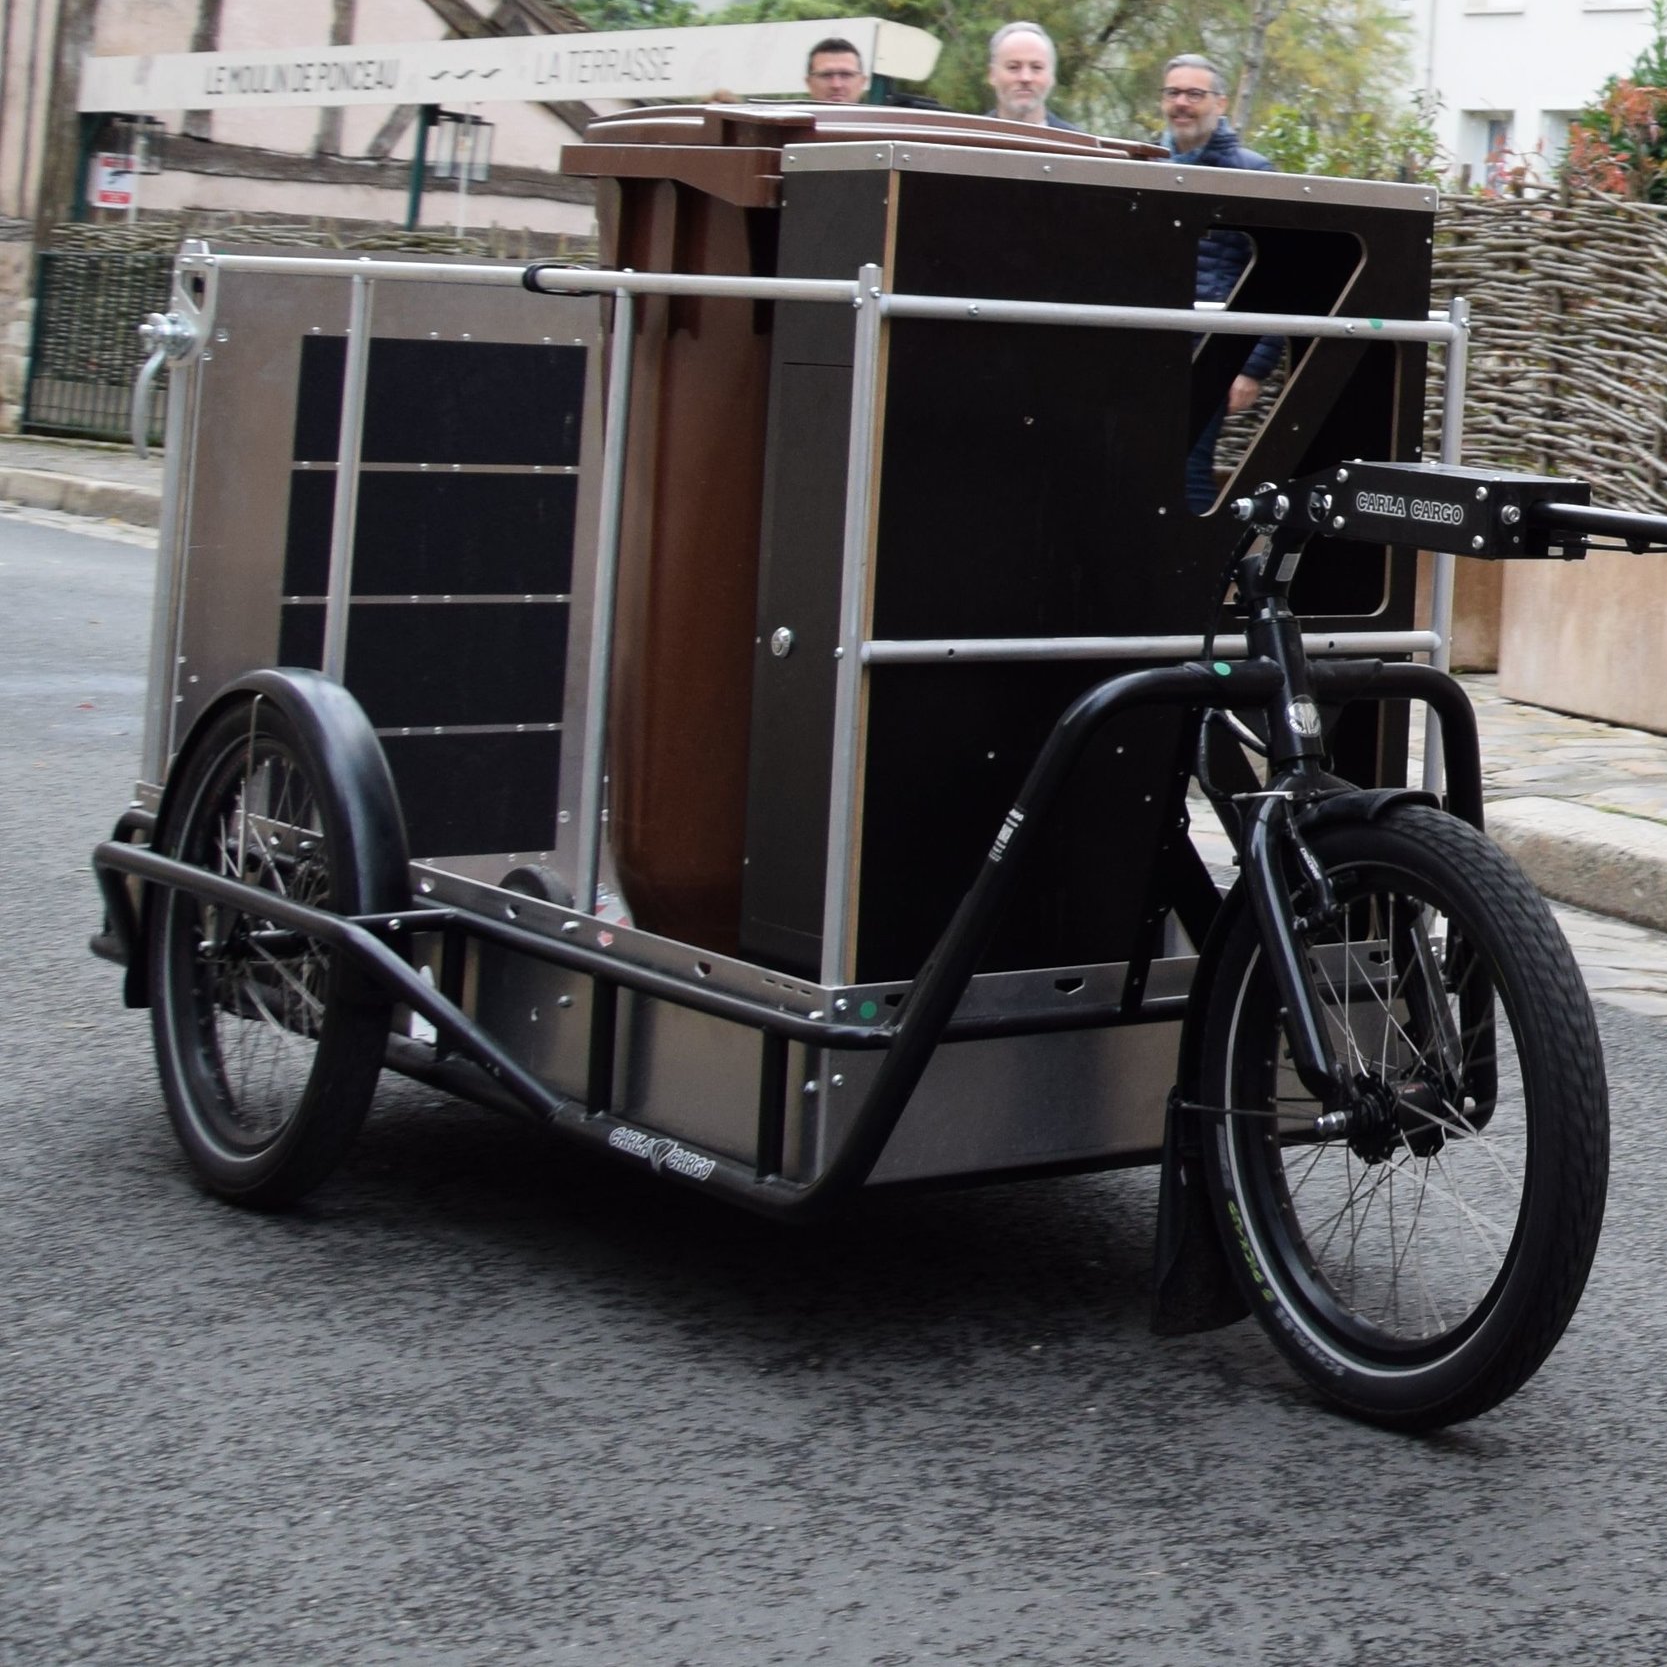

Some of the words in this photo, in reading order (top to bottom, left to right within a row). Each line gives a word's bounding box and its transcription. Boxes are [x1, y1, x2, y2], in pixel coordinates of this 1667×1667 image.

[204, 65, 225, 95] LE
[229, 63, 289, 95] MOULIN
[291, 62, 314, 93] DE
[316, 59, 401, 92] PONCEAU
[534, 51, 561, 85] LA
[567, 46, 676, 84] TERRASSE
[1356, 491, 1406, 518] CARLA
[1410, 499, 1464, 525] CARGO
[608, 1126, 656, 1159] CARLA
[665, 1147, 716, 1181] CARGO
